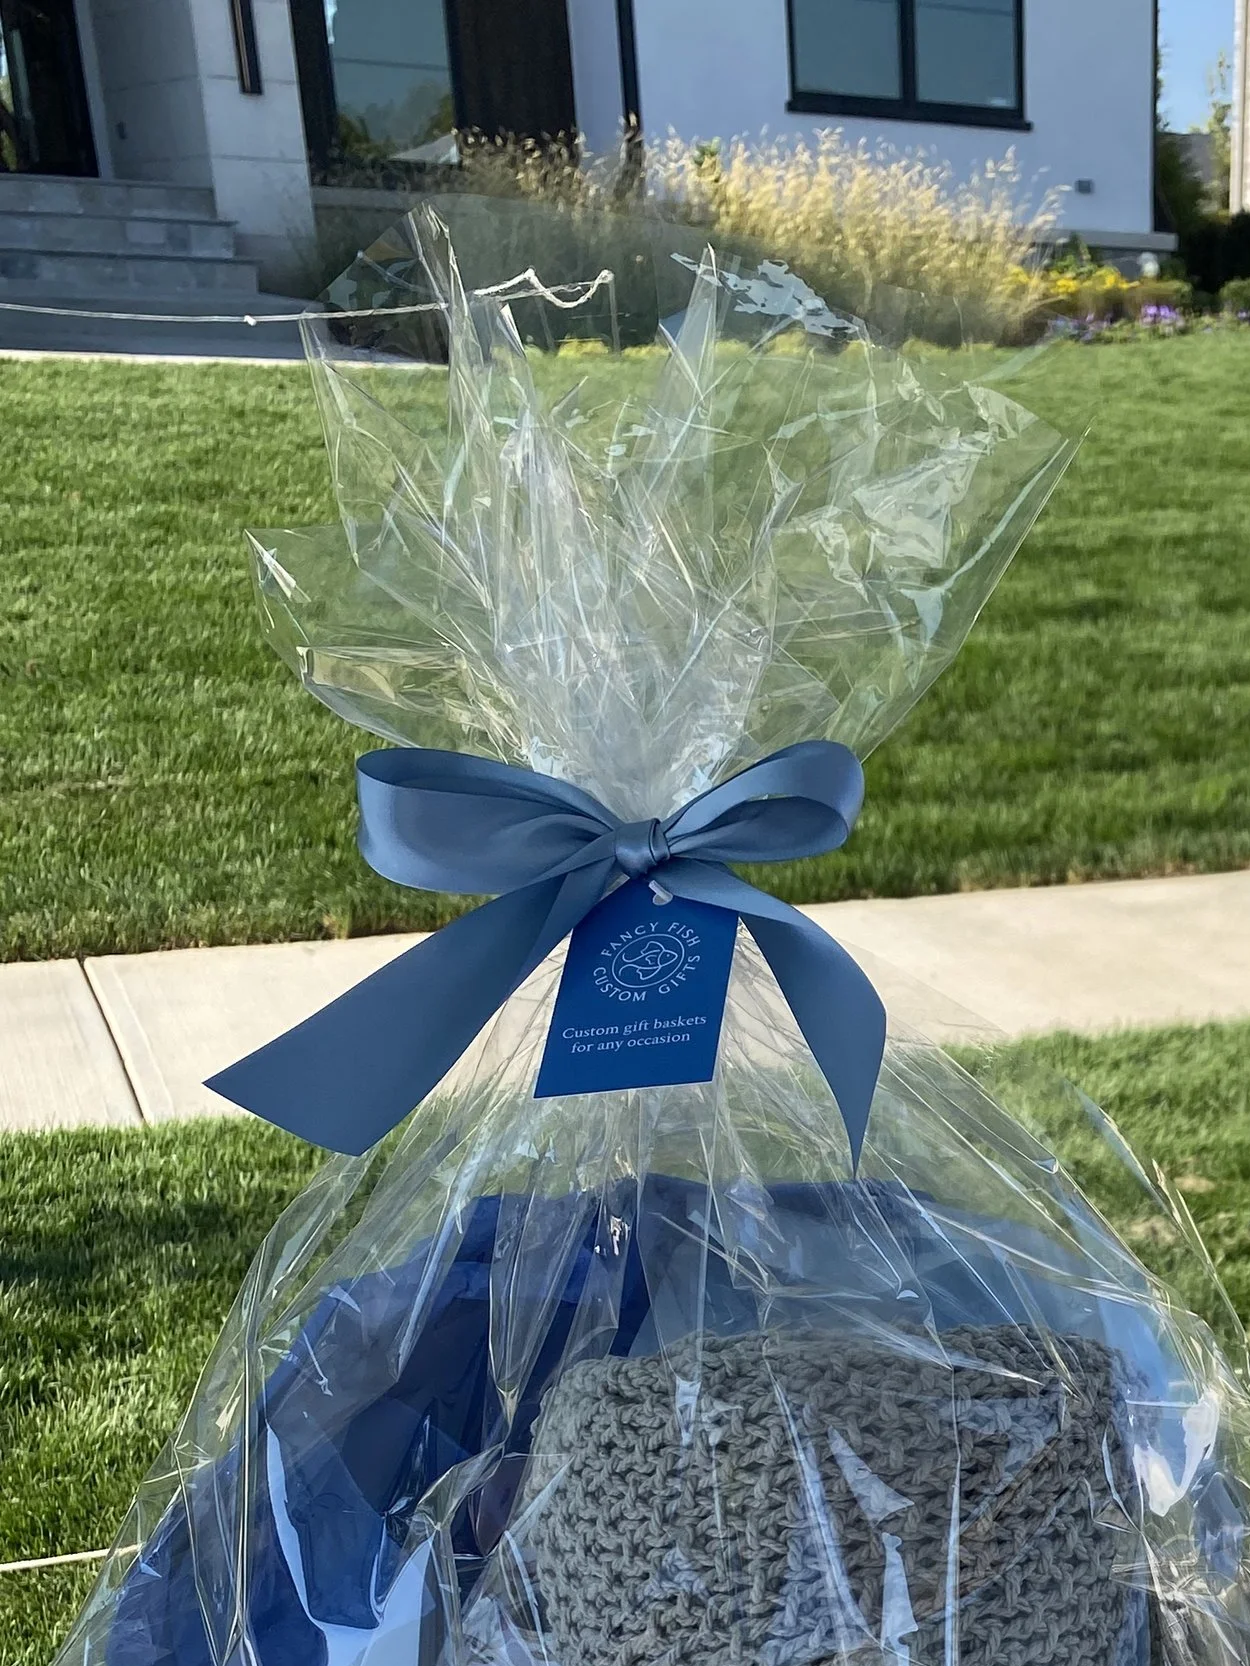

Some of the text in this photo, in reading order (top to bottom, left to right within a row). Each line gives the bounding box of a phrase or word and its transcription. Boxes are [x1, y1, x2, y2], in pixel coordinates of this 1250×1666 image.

[601, 921, 701, 957] FANCY FISH
[593, 954, 701, 1002] CUSTOM GIFTS
[562, 1014, 707, 1040] Custom gift baskets
[571, 1032, 690, 1054] for any occasion
